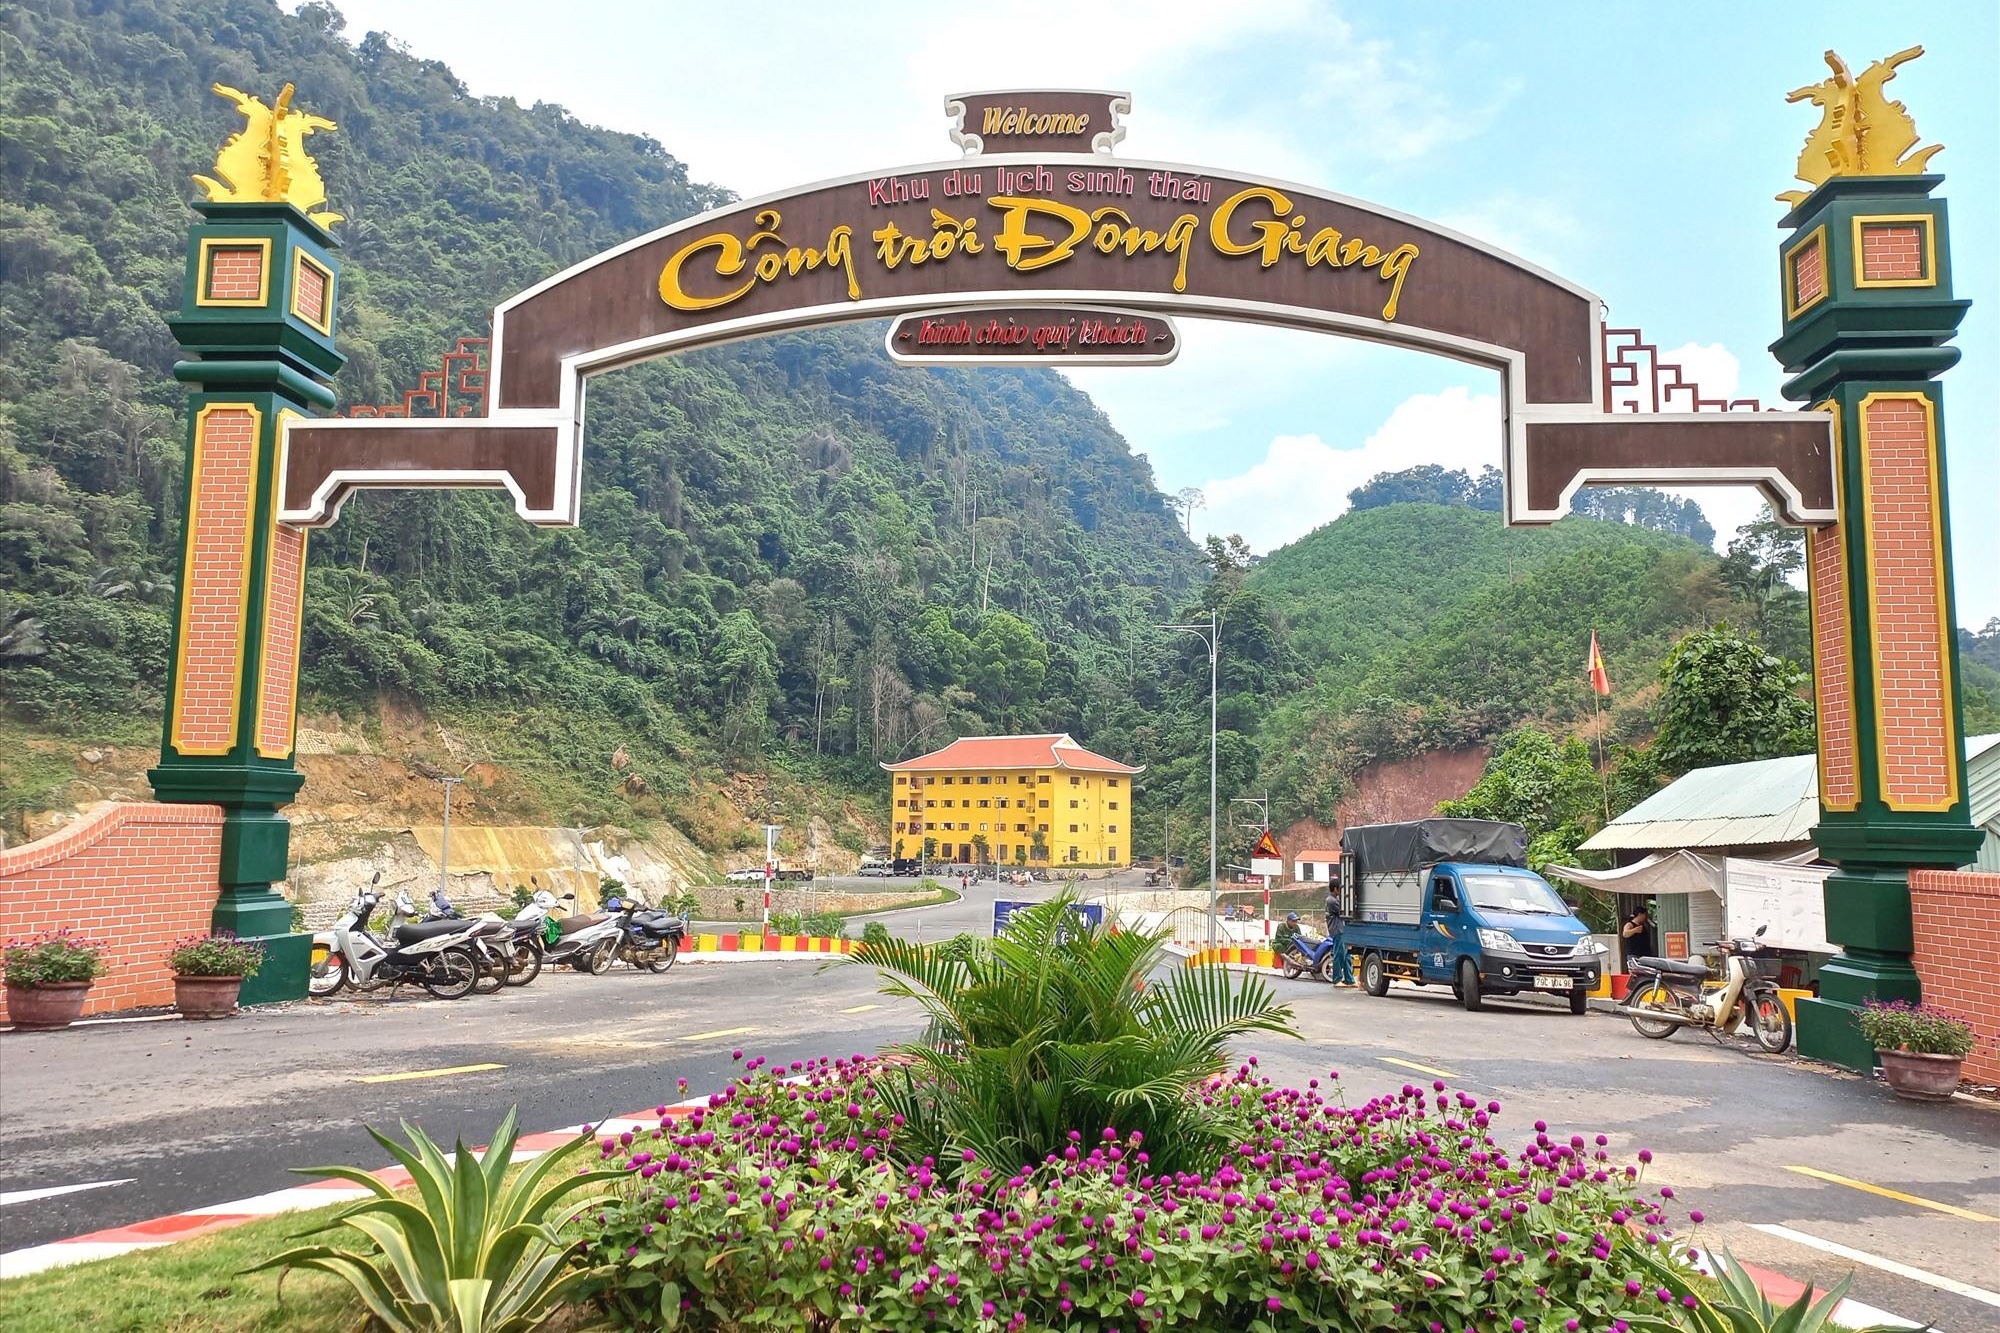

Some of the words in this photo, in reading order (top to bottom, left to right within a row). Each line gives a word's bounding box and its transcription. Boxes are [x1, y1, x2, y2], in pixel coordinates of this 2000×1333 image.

[982, 107, 1090, 136] Welcome
[868, 176, 930, 206] Khu
[943, 169, 982, 197] du
[997, 165, 1053, 196] lịch
[1067, 167, 1134, 195] sinh
[658, 210, 862, 311] Cổng
[872, 208, 984, 269] trời
[988, 196, 1199, 293] Đông
[1209, 186, 1419, 322] Giang
[1078, 317, 1148, 344] khách
